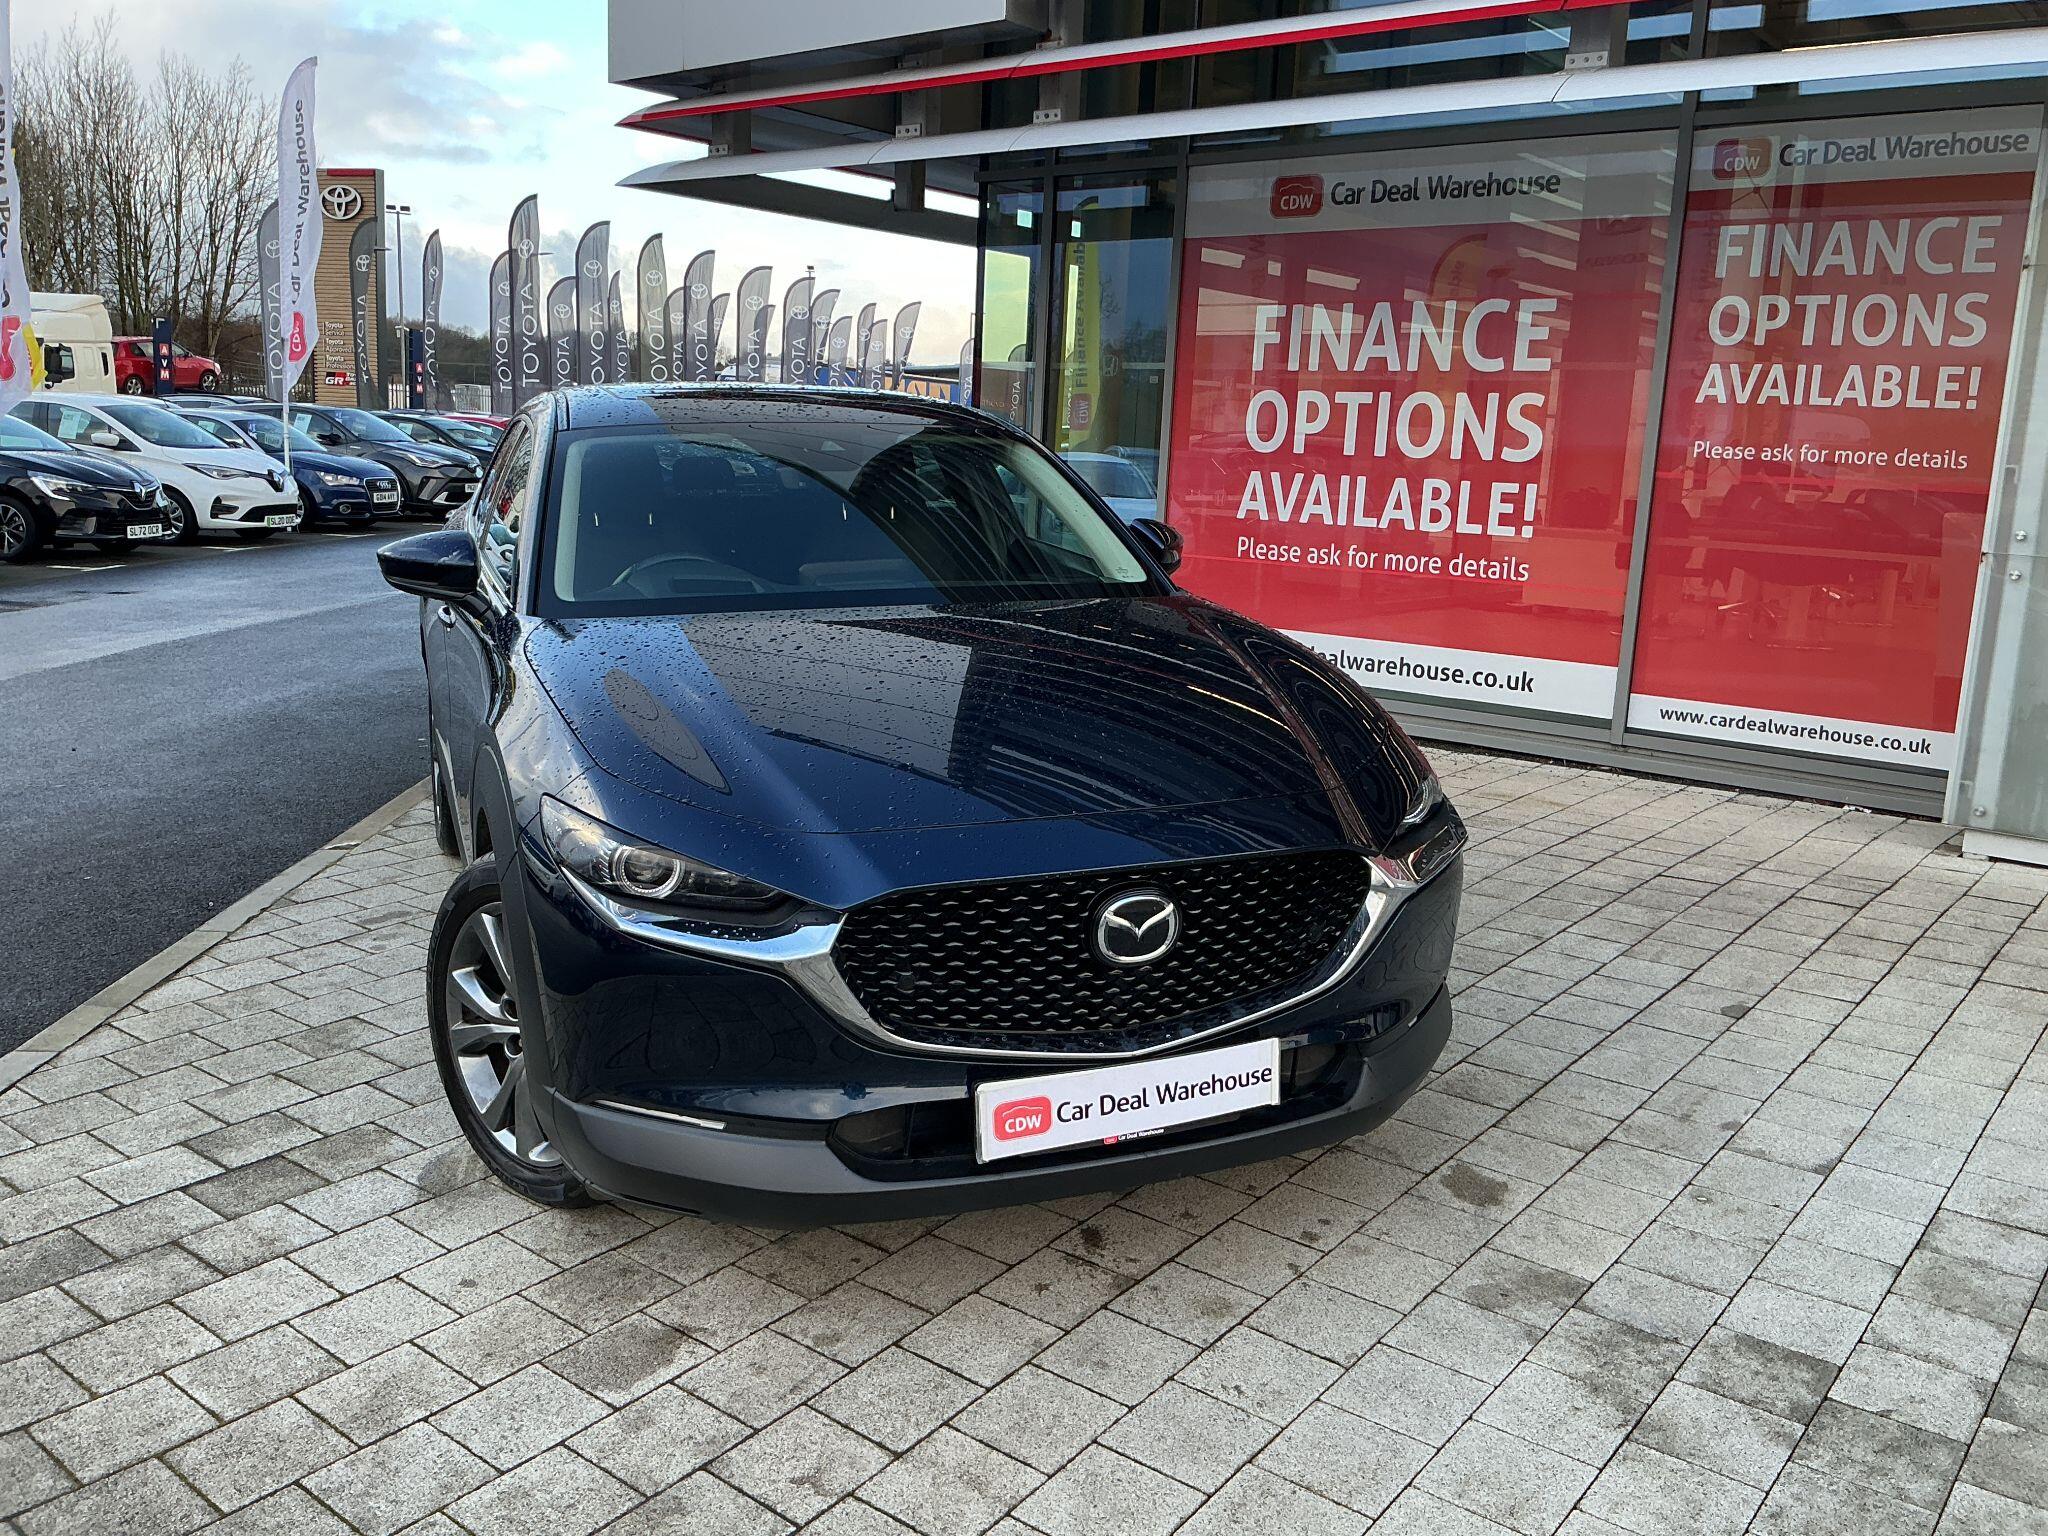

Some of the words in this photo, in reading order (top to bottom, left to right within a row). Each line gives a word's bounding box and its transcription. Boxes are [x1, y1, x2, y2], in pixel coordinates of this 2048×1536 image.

[295, 99, 310, 218] Warehouse
[1723, 155, 1761, 172] CDW
[1779, 143, 1818, 167] Car
[1823, 138, 1878, 165] Deal
[1885, 131, 2030, 160] Warehouse
[1280, 193, 1314, 211] CDW
[1331, 181, 1366, 206] Car
[1370, 176, 1420, 205] Deal
[1427, 171, 1561, 200] Warehouse
[1714, 215, 2003, 279] FINANCE
[268, 282, 283, 383] TOYOTA
[521, 282, 540, 387] TOYOTA
[1252, 298, 1558, 373] FINANCE
[1708, 292, 1990, 348] OPTIONS
[496, 315, 512, 393] TOYOTA
[325, 376, 344, 385] GR
[1694, 363, 1982, 411] AVAILABLE!
[1245, 389, 1546, 463] OPTIONS
[1692, 440, 1755, 461] Please
[1761, 443, 1794, 463] ask
[1799, 443, 1829, 464] for
[1834, 449, 1888, 467] more
[1893, 447, 1968, 470] details
[1236, 470, 1538, 539] AVAILABLE!
[1237, 536, 1301, 563] Please
[1306, 543, 1341, 566] ask
[1347, 544, 1378, 569] for
[1384, 552, 1442, 575] more
[1448, 552, 1530, 582] details
[1311, 646, 1535, 693] ealwarehouse.co.uk
[1659, 708, 1932, 755] www.cardealwarehouse.co.uk
[1056, 1101, 1093, 1123] Car
[1099, 1088, 1150, 1116] Deal
[1155, 1067, 1273, 1105] Warehouse
[1004, 1112, 1043, 1134] CDW
